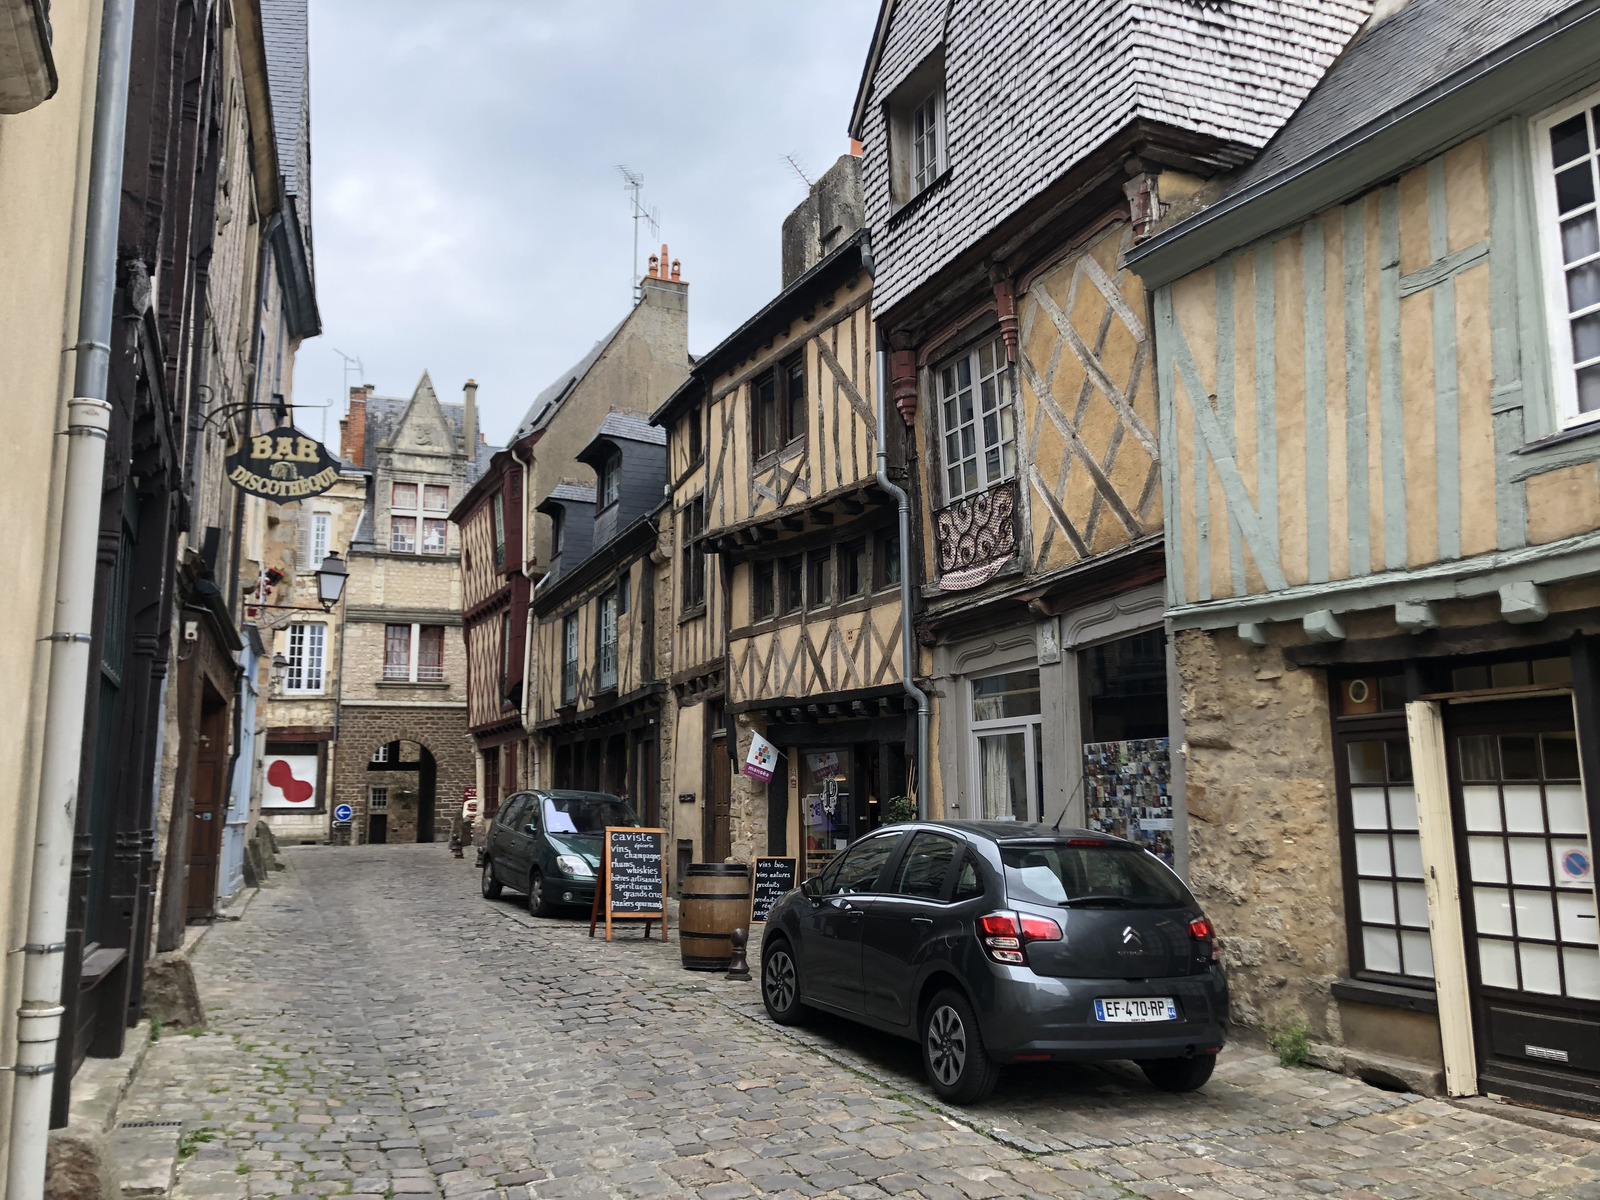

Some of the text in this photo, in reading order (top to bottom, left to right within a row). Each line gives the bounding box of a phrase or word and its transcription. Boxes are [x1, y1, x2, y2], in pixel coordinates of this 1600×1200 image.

[250, 435, 320, 463] BAR
[611, 832, 652, 842] caviste
[611, 845, 629, 853] vins
[626, 865, 658, 874] whiskies
[614, 882, 652, 891] spiritueux
[622, 891, 648, 900] grands
[1105, 1001, 1164, 1017] EF-470-RP
